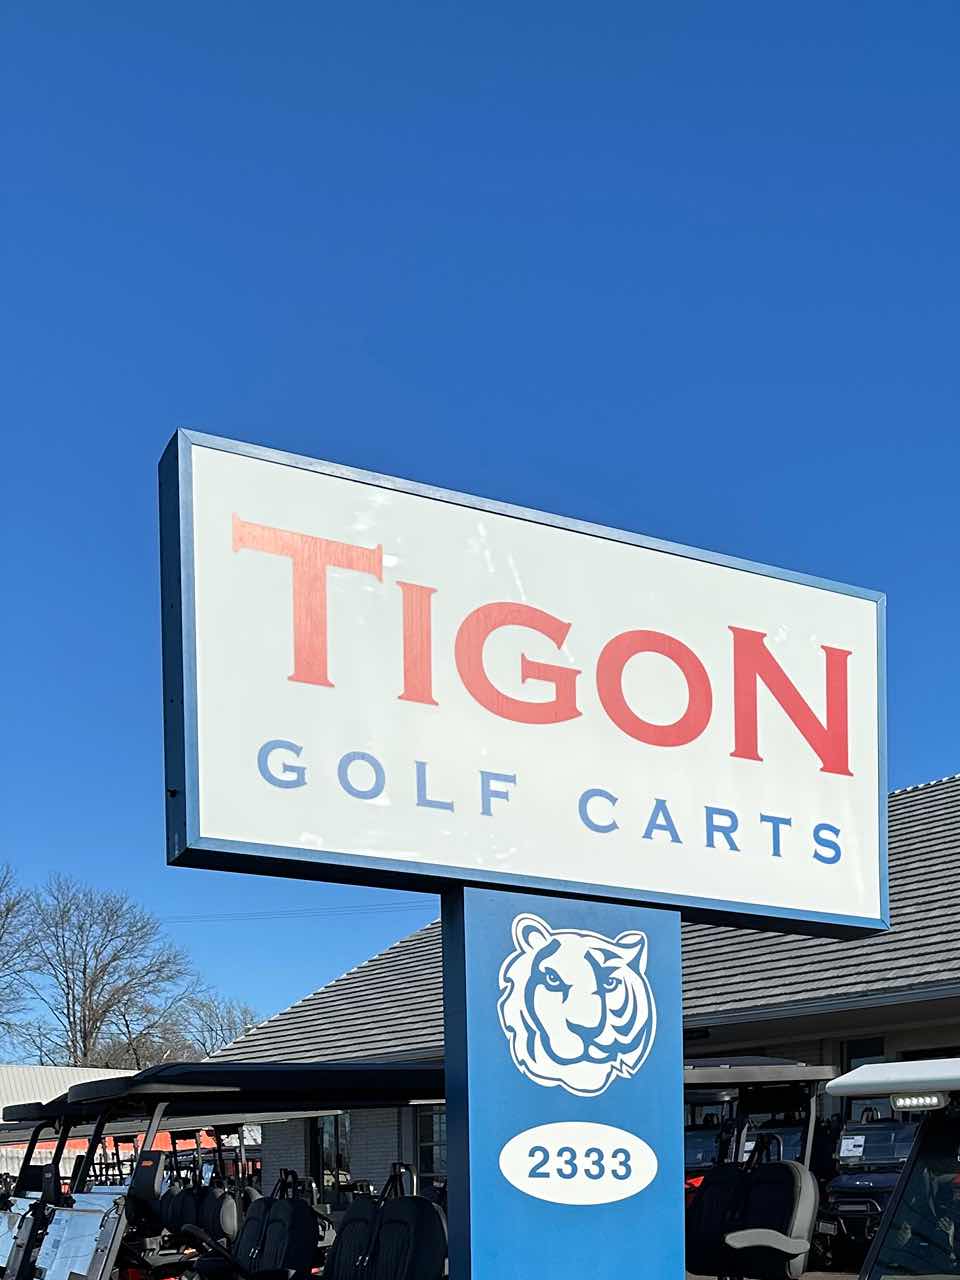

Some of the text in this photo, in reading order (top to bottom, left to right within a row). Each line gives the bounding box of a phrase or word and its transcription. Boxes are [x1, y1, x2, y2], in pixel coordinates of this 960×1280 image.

[231, 512, 854, 777] TIGON
[257, 739, 843, 866] GOLF CARTS
[527, 1146, 632, 1181] 2333
